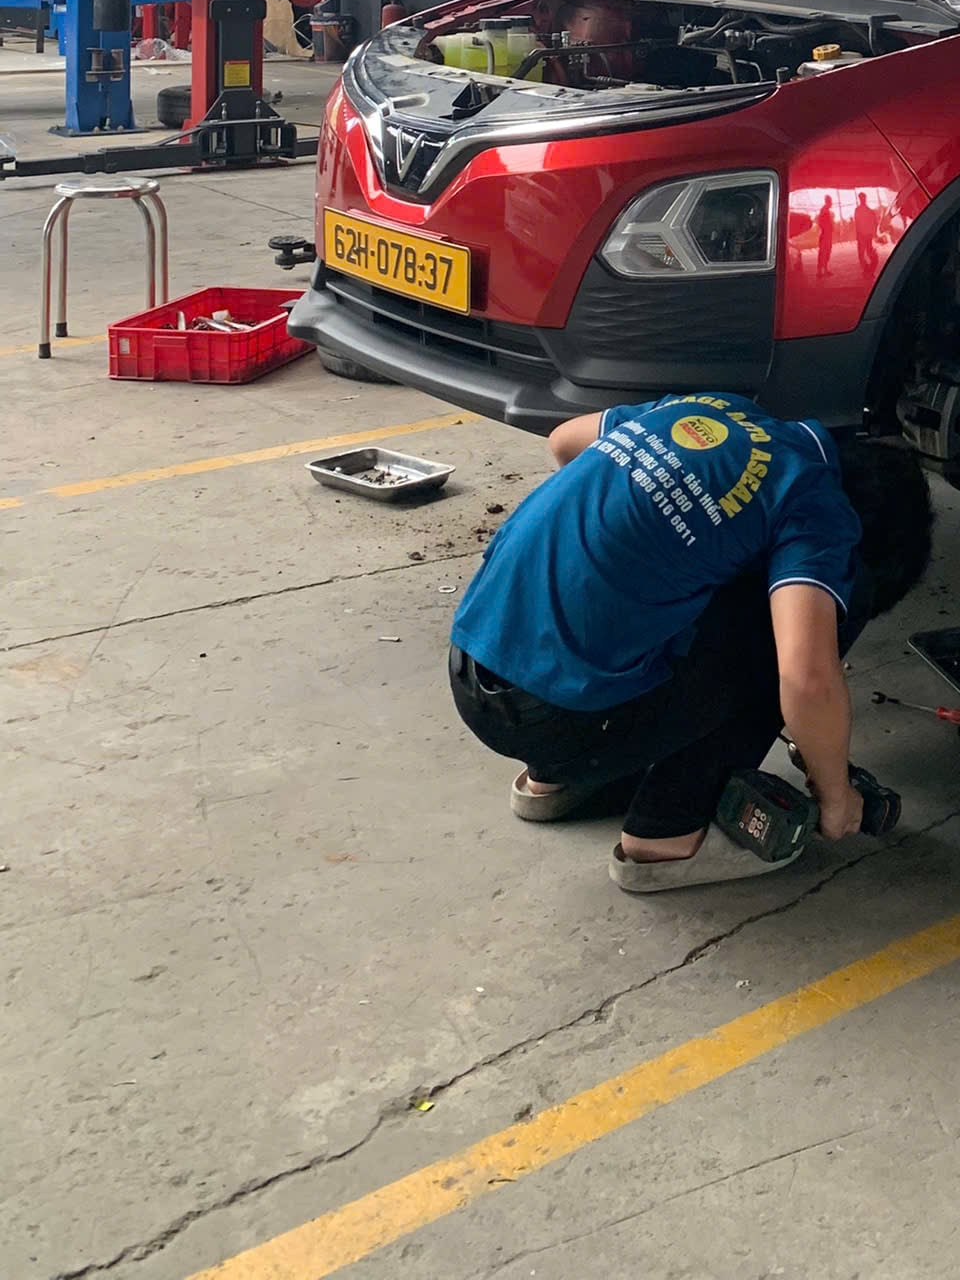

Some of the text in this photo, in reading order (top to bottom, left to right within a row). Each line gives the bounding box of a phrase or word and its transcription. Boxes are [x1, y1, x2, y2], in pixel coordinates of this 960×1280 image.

[687, 420, 715, 444] AUTO
[610, 448, 631, 467] 650
[631, 468, 657, 494] 0898
[652, 491, 674, 516] 916
[670, 513, 697, 547] 6811
[633, 447, 659, 470] 0903
[653, 467, 676, 489] 903
[670, 487, 694, 513] 860
[682, 471, 704, 497] Bảo
[718, 447, 772, 518] ASEAN
